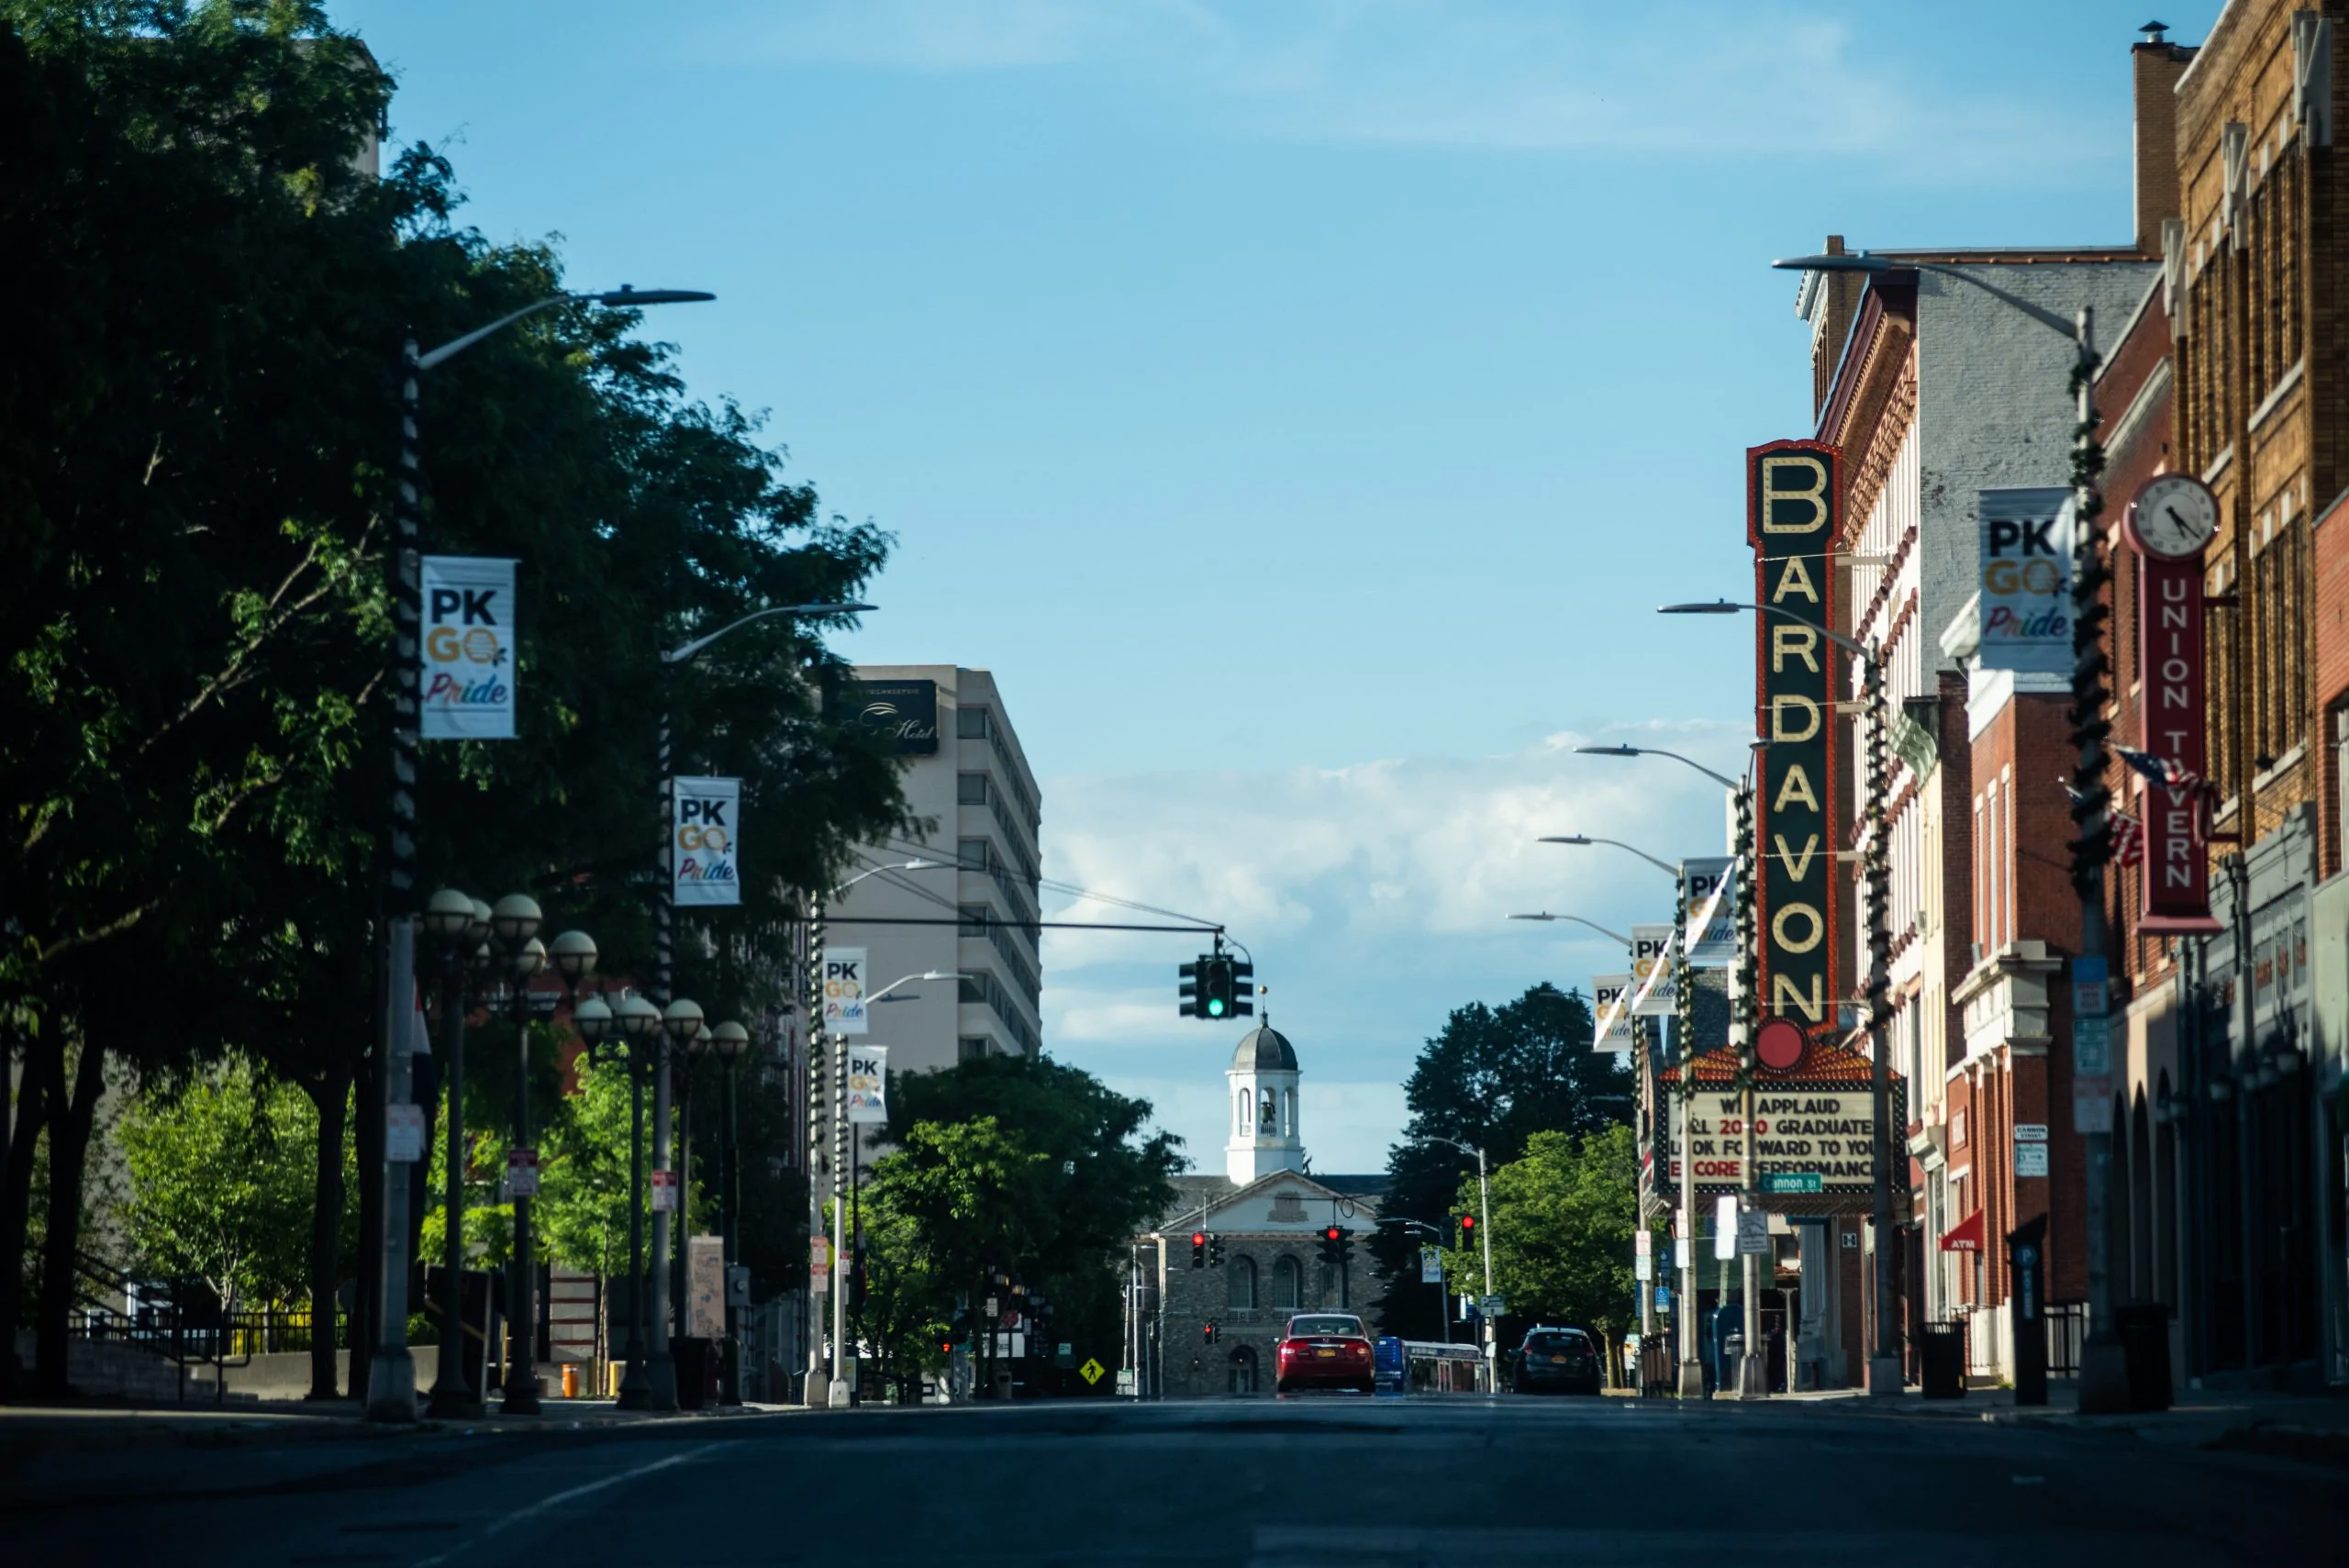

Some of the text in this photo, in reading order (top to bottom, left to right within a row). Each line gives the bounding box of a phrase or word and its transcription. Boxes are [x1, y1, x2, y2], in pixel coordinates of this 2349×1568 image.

[1989, 520, 2056, 557] PK
[430, 588, 497, 625] PK
[1984, 606, 2069, 639] Pride
[2161, 578, 2189, 709] UNION
[426, 673, 508, 706] Pride
[1762, 456, 1828, 1022] BARDAVON
[680, 798, 727, 827] PK
[677, 857, 735, 881] Pride
[1637, 940, 1670, 959] PK
[827, 963, 858, 980] PK
[1597, 987, 1625, 1005] PK
[827, 1002, 863, 1018] Pride
[852, 1060, 877, 1075] PK
[850, 1095, 882, 1108] Pride
[1757, 1098, 1841, 1115] APPLAUD
[1720, 1119, 1768, 1135] 200
[1776, 1118, 1876, 1135] GRADUATE
[1723, 1140, 1812, 1156] FOWARD
[1818, 1140, 1842, 1156] TO
[1670, 1161, 1875, 1176] ECORE ERFORMANC
[1763, 1176, 1817, 1189] Cannon St
[1951, 1240, 1976, 1249] ATM
